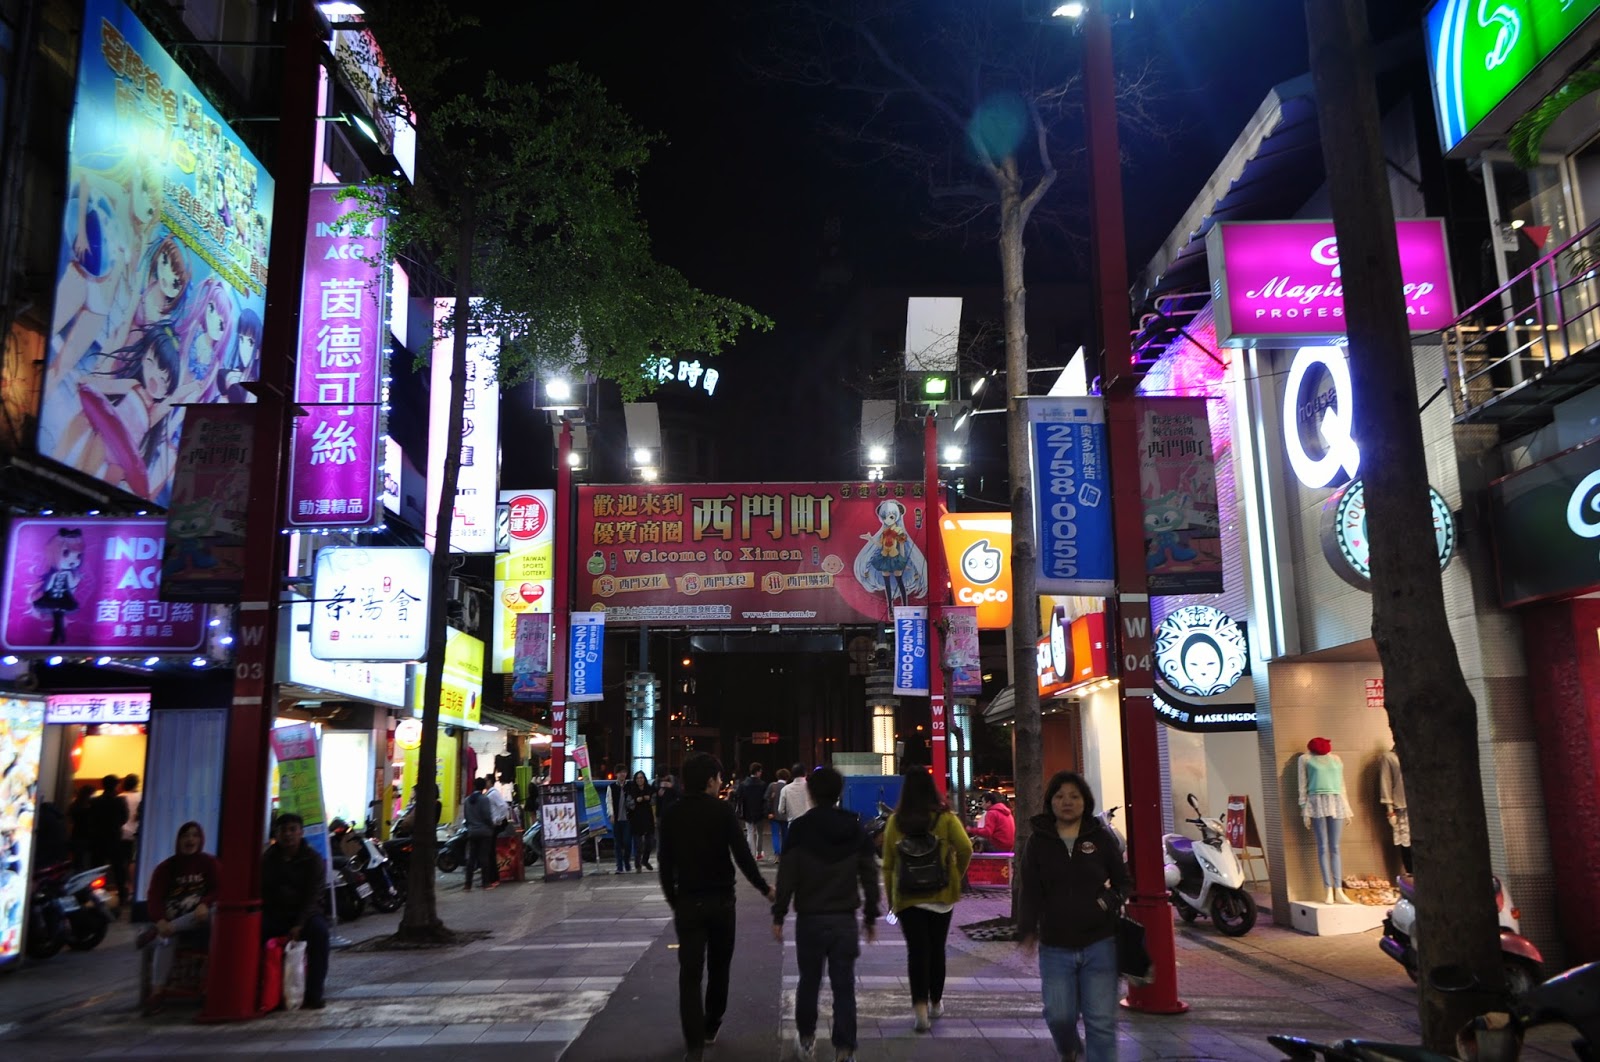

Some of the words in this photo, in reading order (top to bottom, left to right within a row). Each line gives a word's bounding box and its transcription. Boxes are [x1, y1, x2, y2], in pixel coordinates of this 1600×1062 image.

[324, 244, 364, 260] ACG
[310, 278, 364, 465] 茵德可絲
[1080, 424, 1096, 480] 奧多廣告
[1148, 440, 1203, 458] 西門町
[299, 499, 363, 515] 動漫精品
[511, 504, 539, 517] 台灣
[593, 494, 683, 517] 歡迎來到
[510, 518, 539, 531] 運彩
[691, 494, 833, 541] 西門町
[593, 521, 683, 544] 優質商圈
[623, 549, 706, 563] Welcome
[714, 549, 733, 562] to
[739, 547, 803, 561] Ximen
[118, 566, 161, 589] AC
[619, 576, 662, 590] 西門文化
[958, 587, 1008, 604] CoCo
[97, 600, 194, 622] 茵德可絲
[114, 625, 173, 637] 動漫精品
[241, 626, 264, 646] W
[1124, 617, 1147, 639] W
[236, 663, 262, 679] 03
[1125, 655, 1151, 671] 04
[553, 711, 564, 722] W
[932, 706, 943, 716] W
[552, 728, 563, 736] 01
[932, 722, 944, 730] 02
